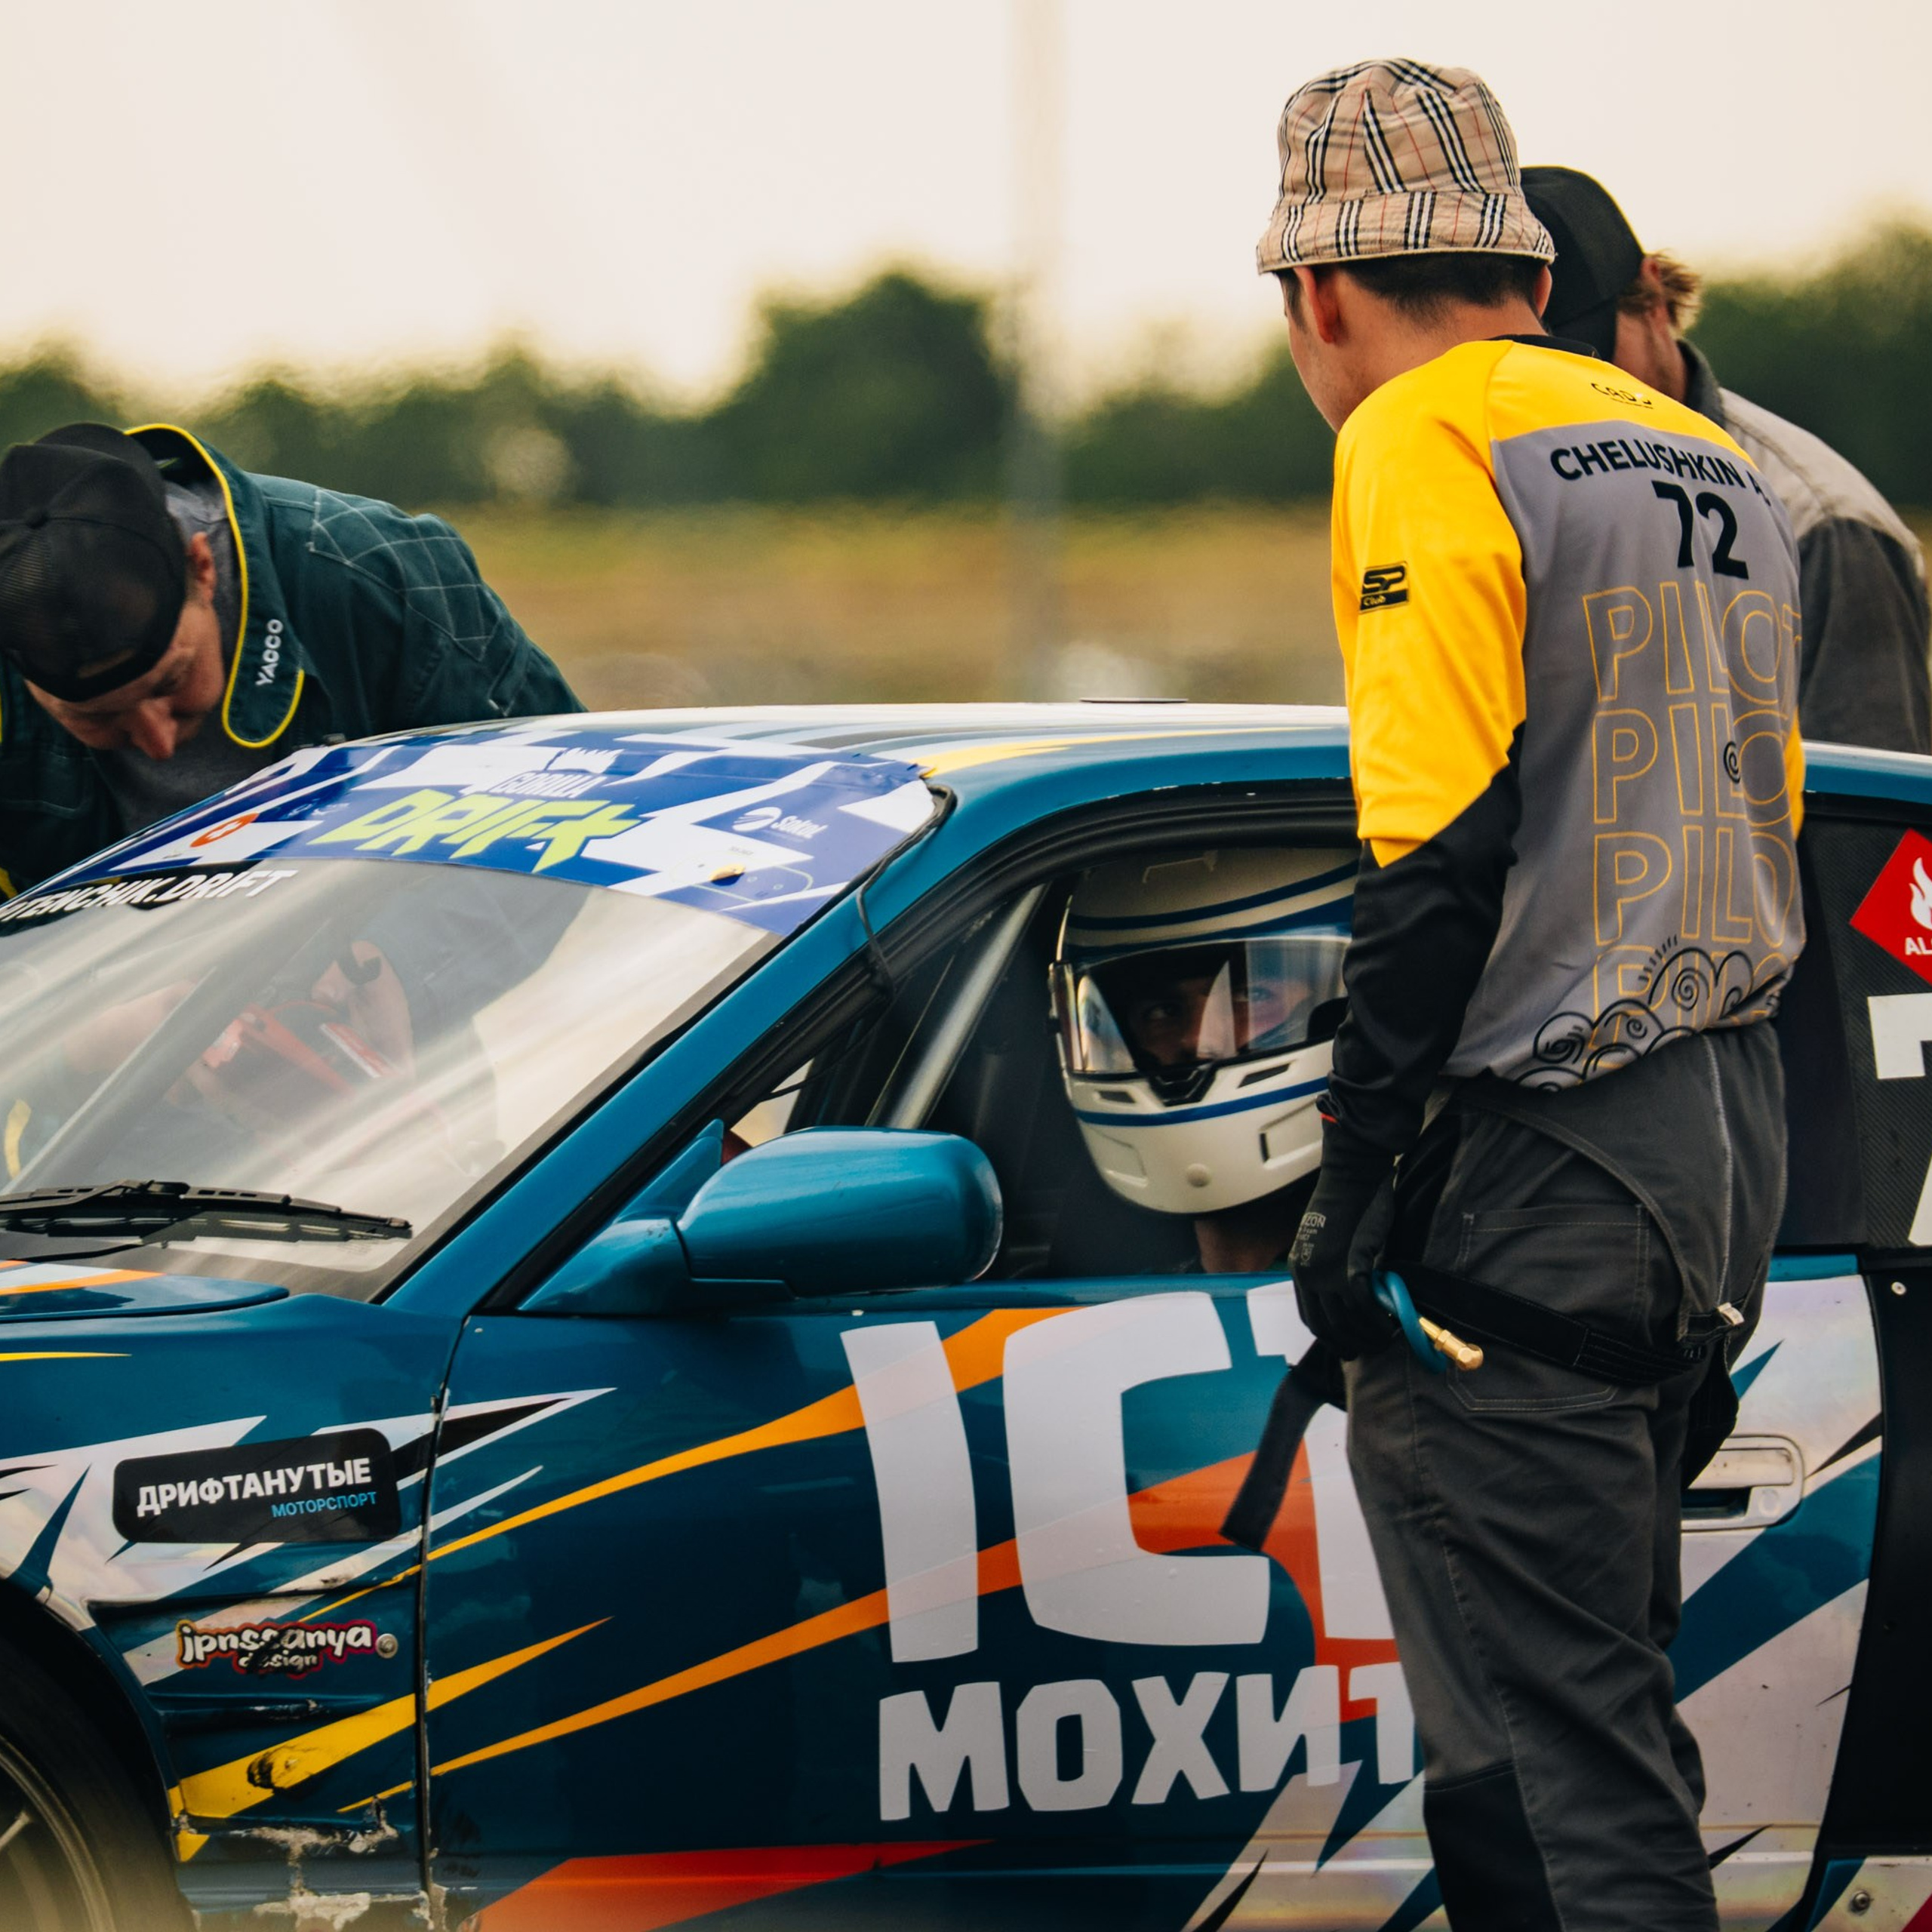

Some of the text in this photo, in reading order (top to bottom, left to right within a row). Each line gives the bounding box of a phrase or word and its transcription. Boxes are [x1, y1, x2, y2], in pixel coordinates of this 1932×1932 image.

[1550, 438, 1747, 489] CHELUSHKIN
[1651, 480, 1749, 580] 72
[1362, 565, 1406, 594] SP
[255, 619, 284, 685] YACCO
[491, 771, 608, 798] GORILLA
[306, 789, 641, 874] DRIFT
[1905, 937, 1932, 955] AL
[137, 1457, 372, 1518] ДРИФТАНУТЫЕ
[272, 1491, 377, 1518] МОТОРСПОРТ
[238, 1649, 318, 1671] dsign
